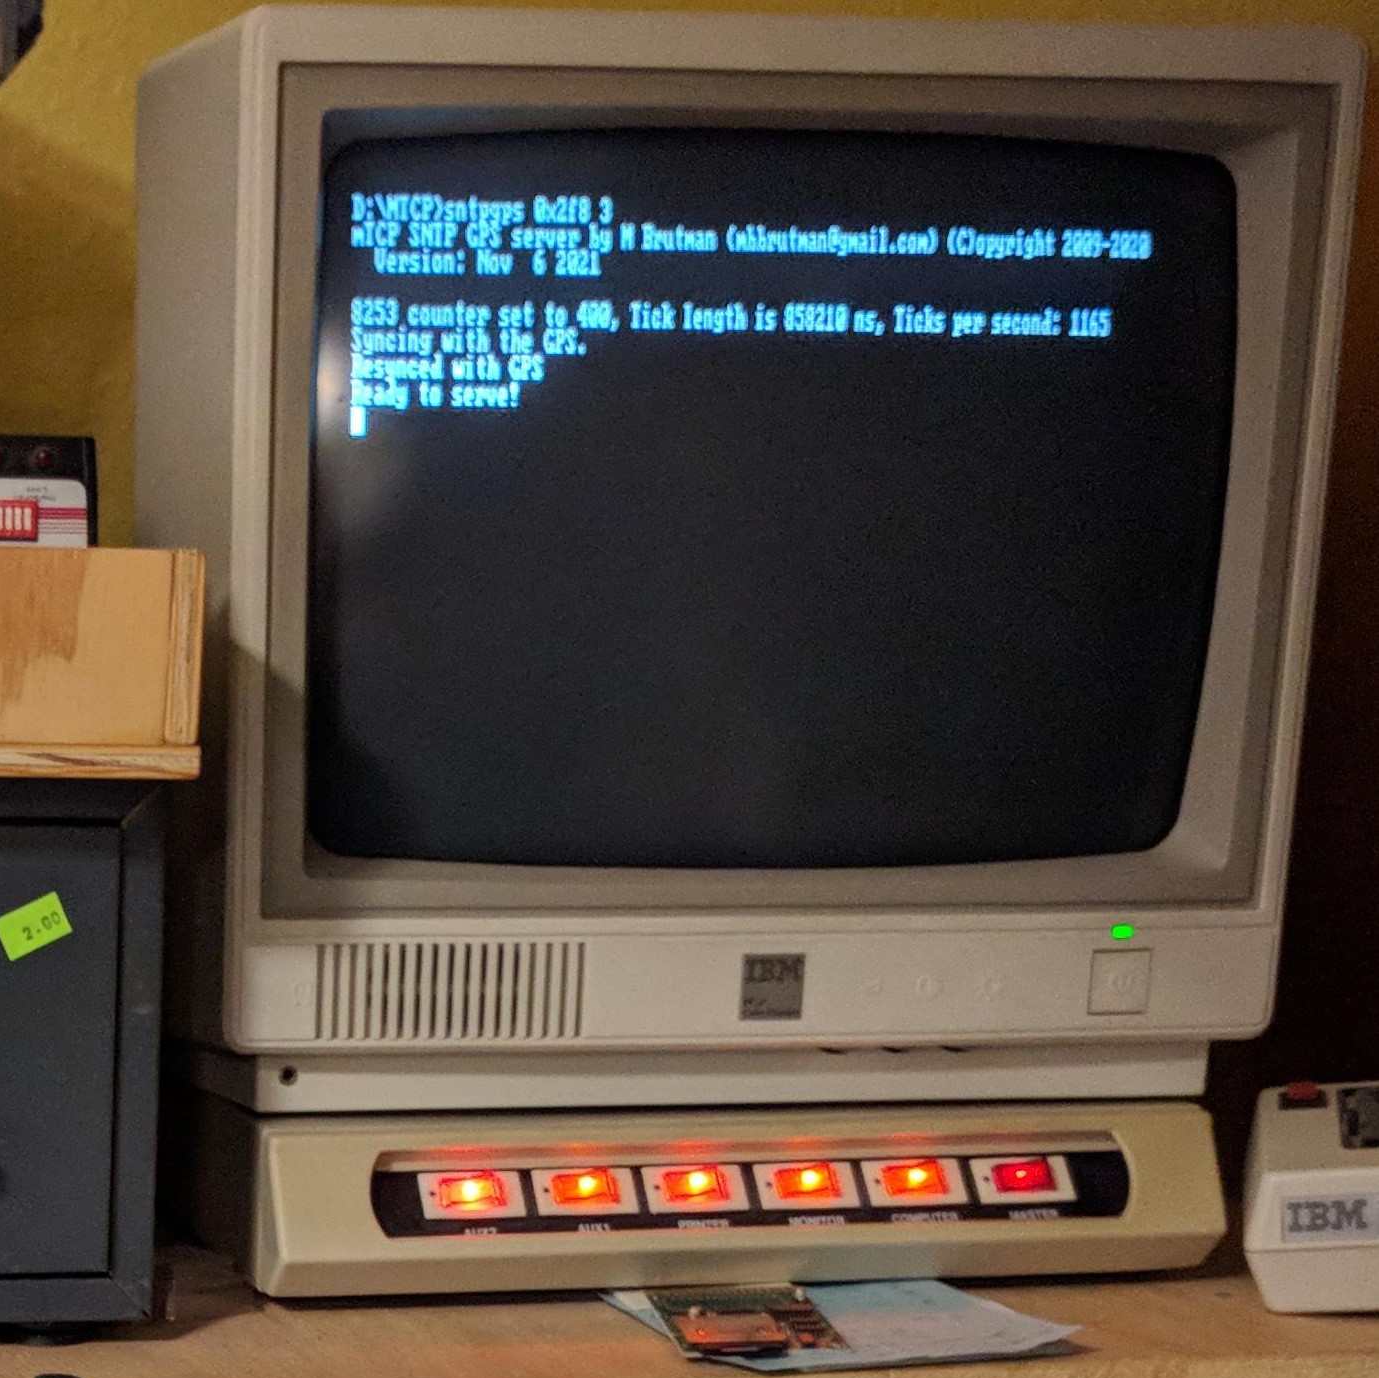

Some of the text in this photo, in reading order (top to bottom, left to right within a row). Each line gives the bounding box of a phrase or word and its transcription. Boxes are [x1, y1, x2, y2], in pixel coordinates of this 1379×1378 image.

[599, 196, 614, 224] 3
[465, 223, 502, 249] GPS
[511, 227, 581, 251] server
[589, 222, 613, 254] by
[641, 222, 719, 252] Brutman
[373, 248, 601, 277] Version: Nov 6 2021
[407, 300, 491, 328] counter
[498, 301, 535, 328] set
[544, 301, 569, 328] to
[628, 300, 676, 331] Tick
[683, 301, 748, 336] length
[753, 303, 777, 332] is
[893, 304, 947, 334] Ticks
[951, 310, 986, 338] per
[991, 306, 1062, 336] second:
[440, 327, 491, 354] with
[500, 328, 533, 354] the
[542, 327, 587, 355] GPS.
[450, 355, 501, 381] with
[508, 354, 545, 381] GPS
[351, 379, 520, 410] Ready to serve!
[21, 910, 63, 941] 2.00
[789, 1214, 846, 1225] MONITOR
[1287, 1199, 1368, 1232] IBM
